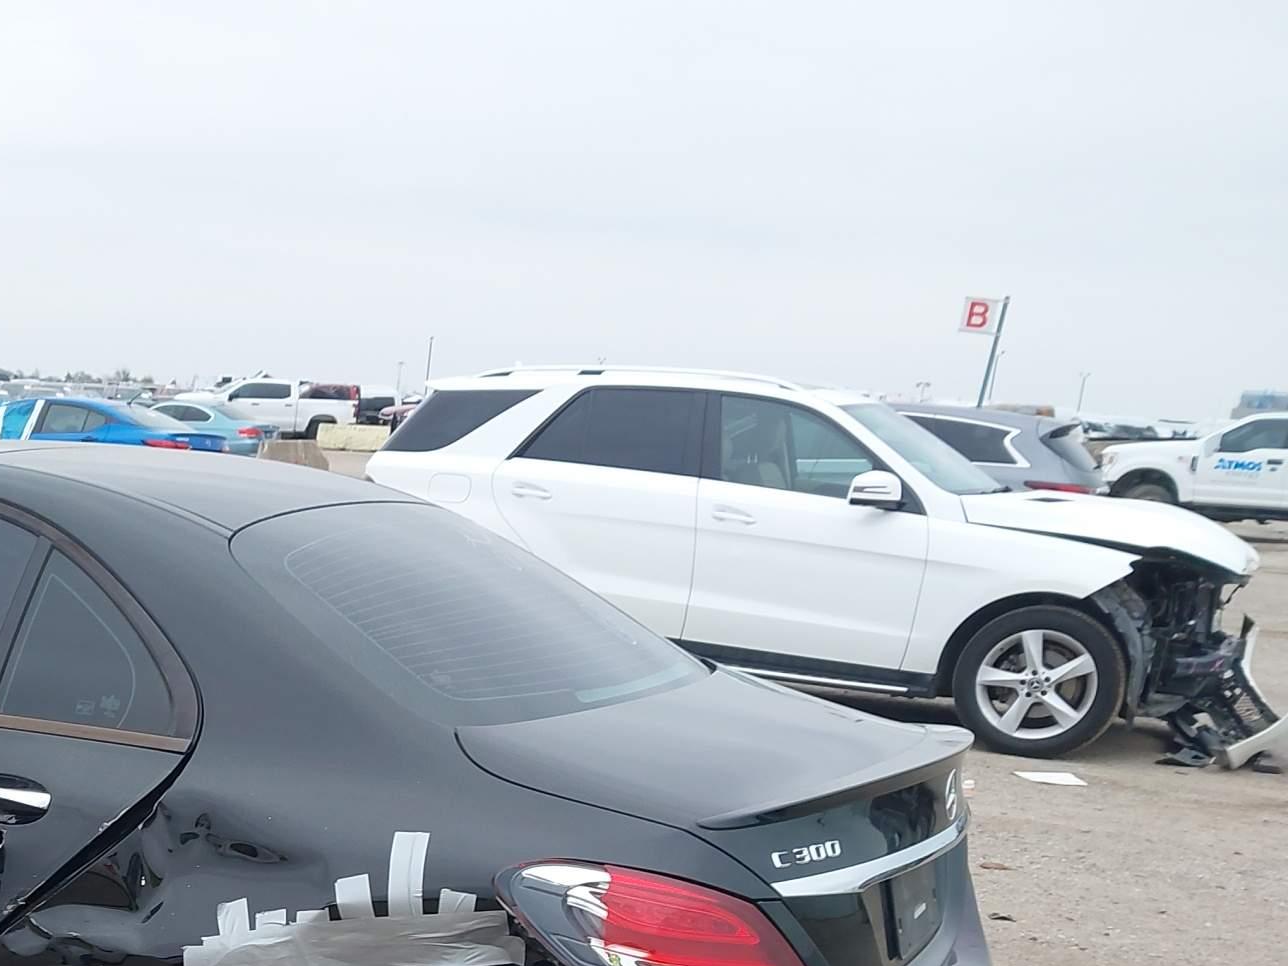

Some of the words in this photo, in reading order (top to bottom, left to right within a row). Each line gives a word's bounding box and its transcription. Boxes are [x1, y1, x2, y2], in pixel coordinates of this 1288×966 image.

[966, 301, 989, 328] B
[771, 851, 792, 868] C
[792, 840, 841, 864] 300
